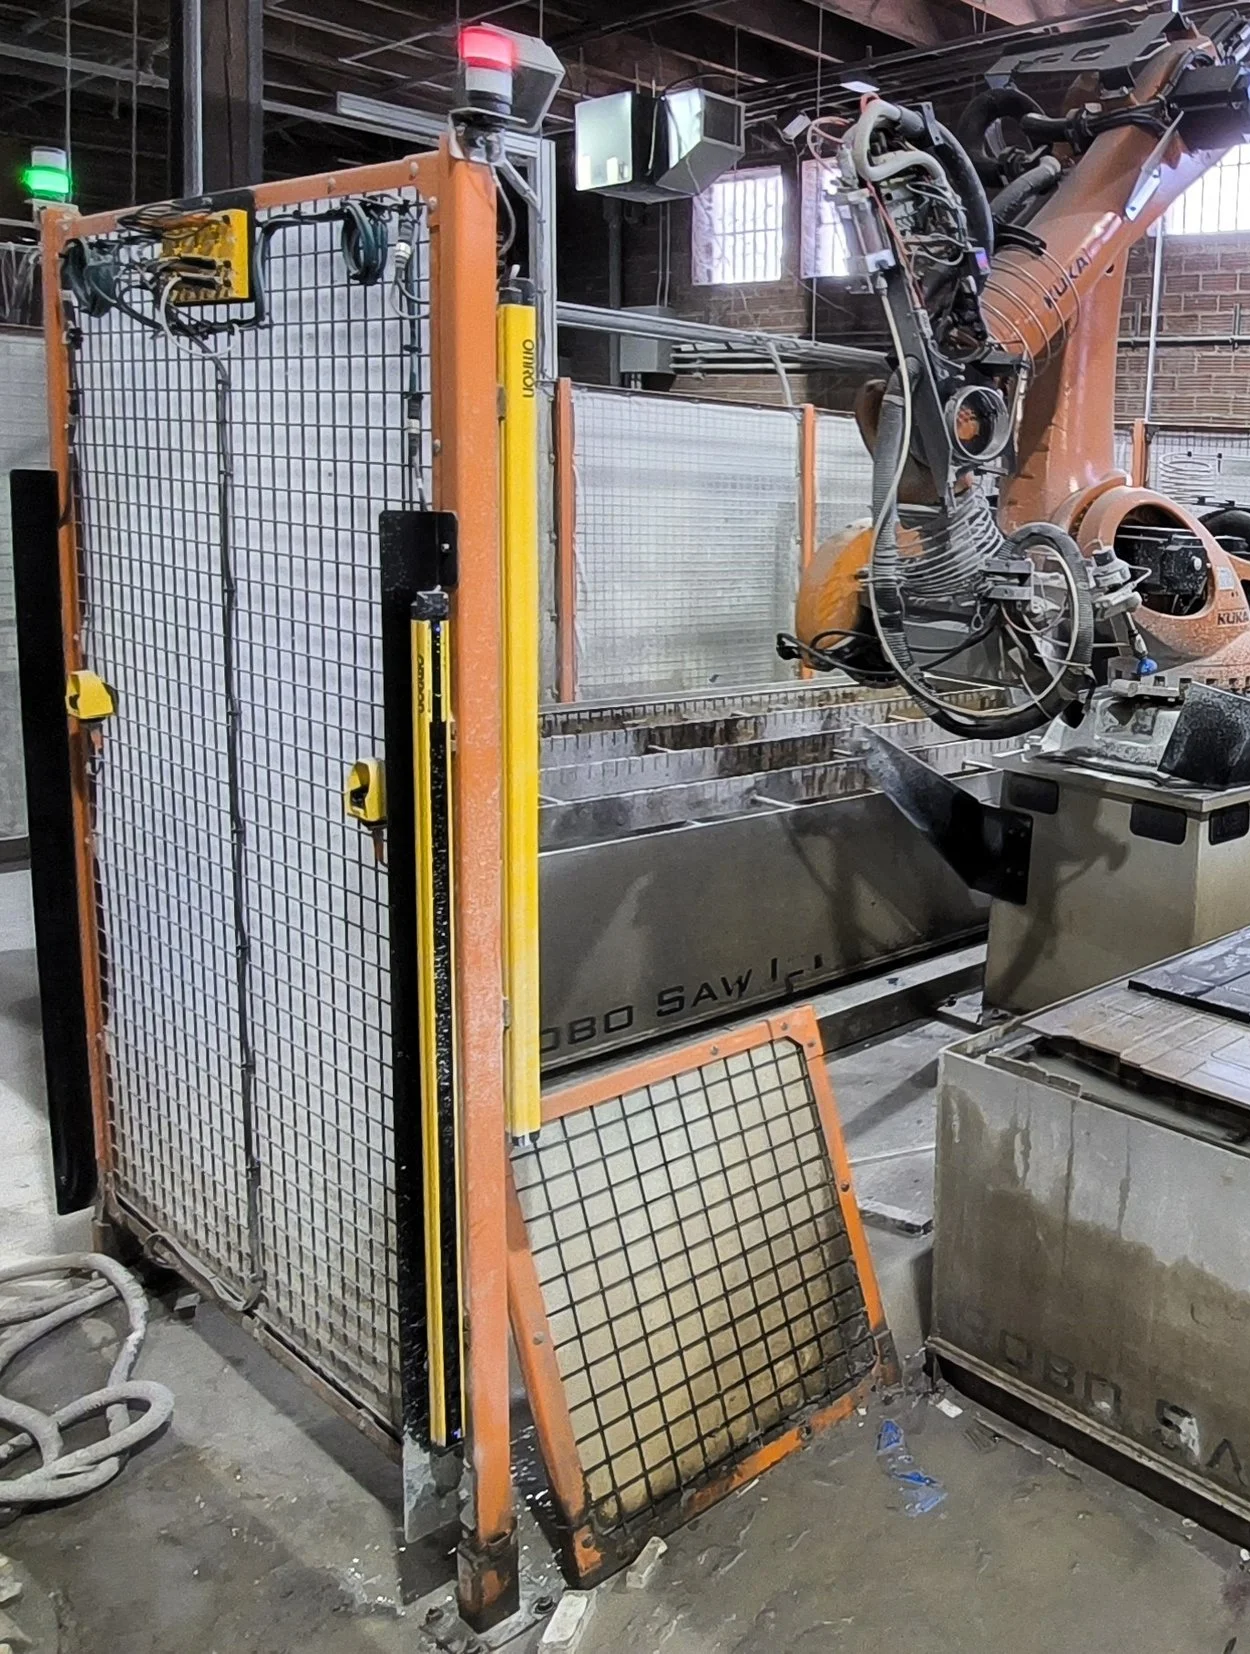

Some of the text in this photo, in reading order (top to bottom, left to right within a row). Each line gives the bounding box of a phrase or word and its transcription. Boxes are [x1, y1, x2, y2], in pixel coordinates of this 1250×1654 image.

[522, 338, 535, 398] OMRON
[1217, 611, 1249, 626] KUKA
[540, 1004, 634, 1054] OBO
